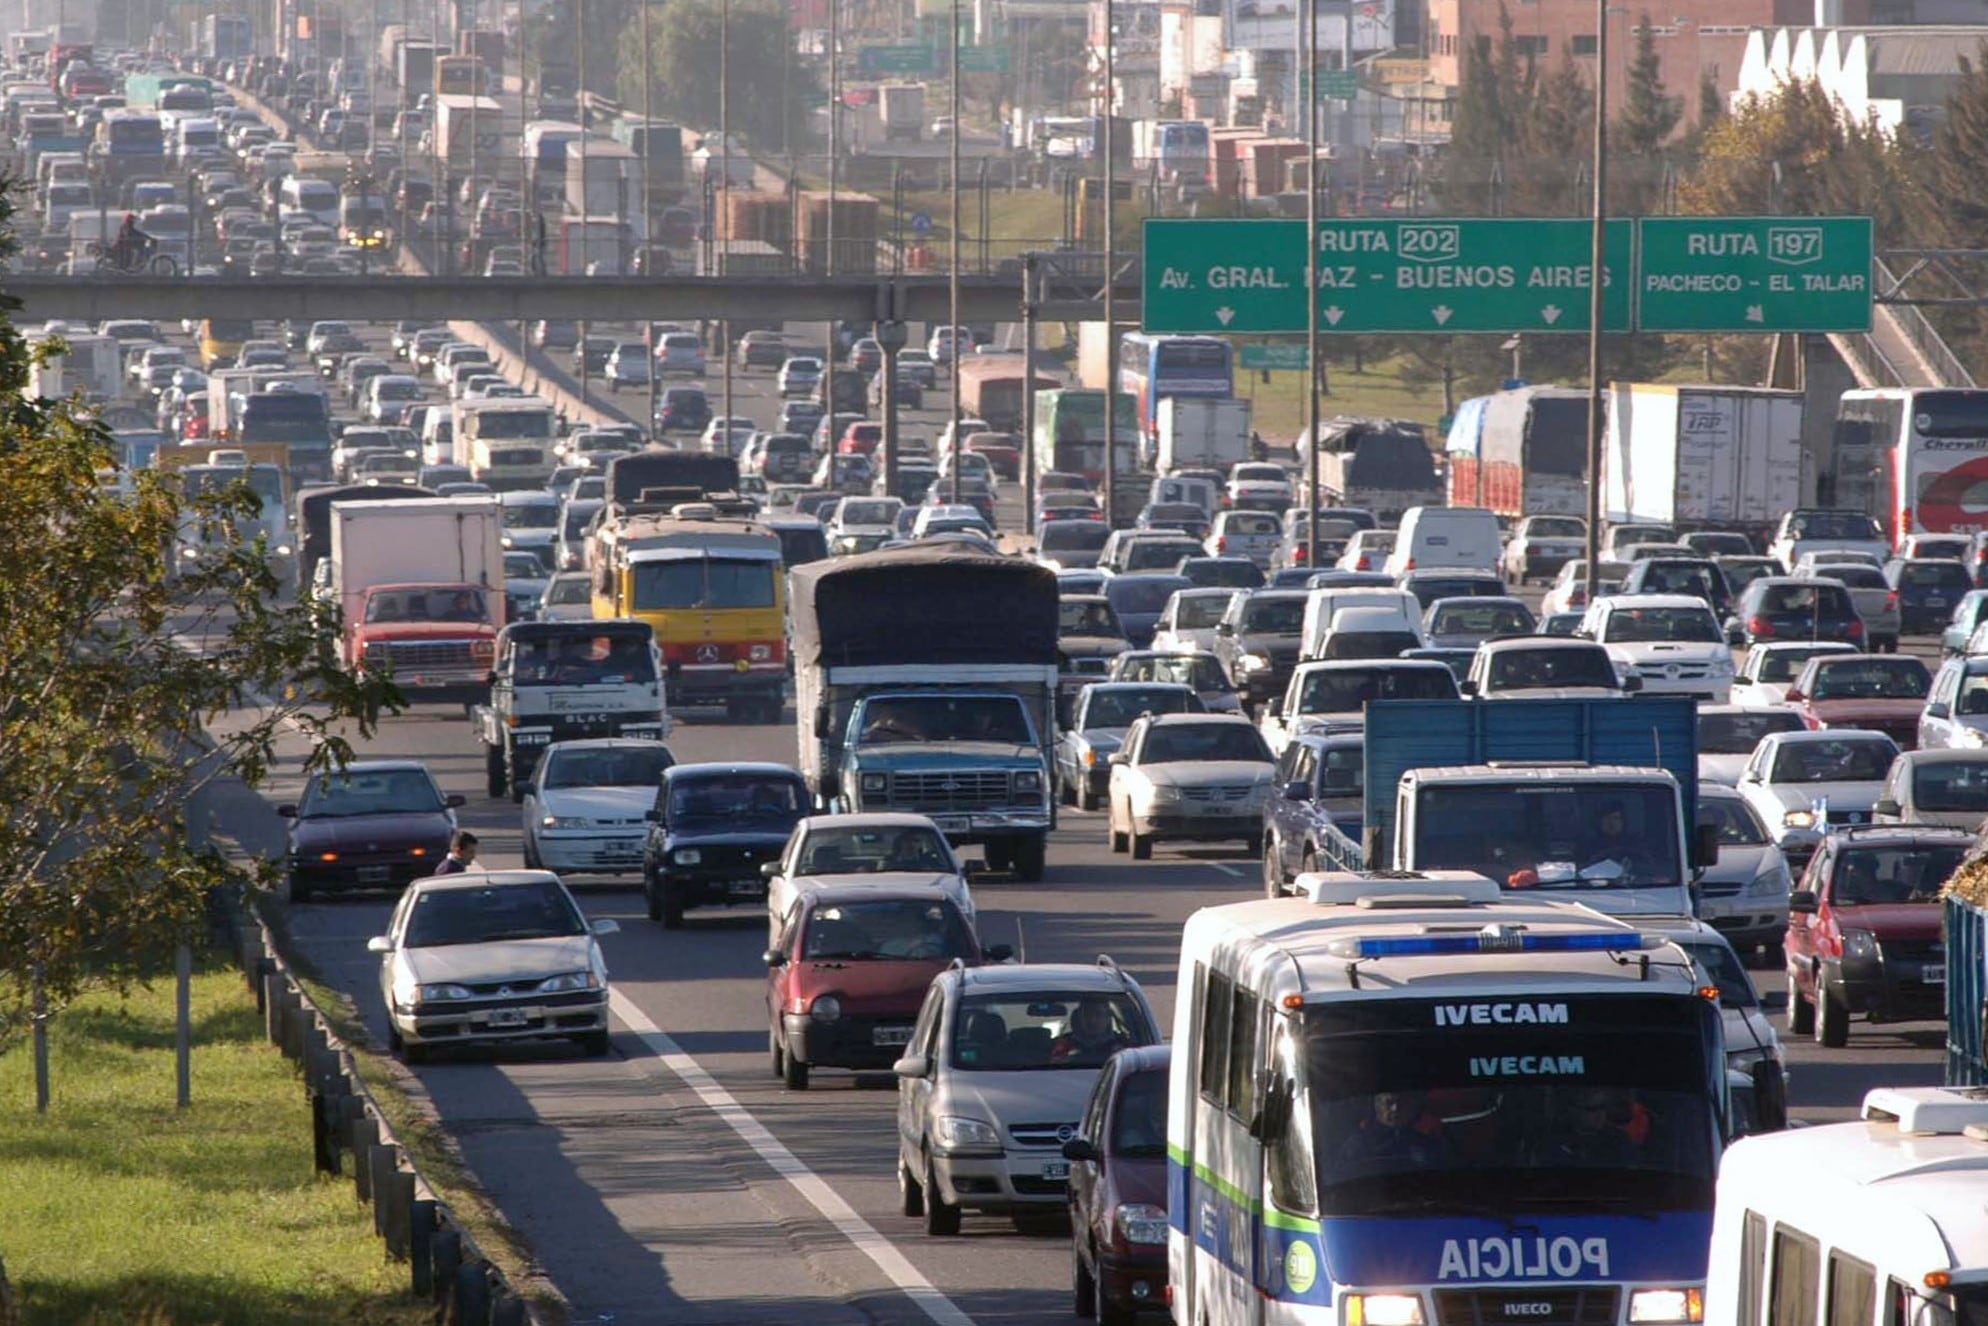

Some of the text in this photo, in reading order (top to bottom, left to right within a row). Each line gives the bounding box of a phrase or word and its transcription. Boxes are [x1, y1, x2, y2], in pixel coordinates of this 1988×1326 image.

[1319, 229, 1455, 252] RUTA 202
[1687, 233, 1820, 256] RUTA 197
[1159, 266, 1196, 289] Av.
[1206, 265, 1290, 289] GRAL.
[1396, 265, 1516, 289] BUENOS
[1646, 274, 1743, 292] PACHECO
[1768, 273, 1795, 292] EL
[1801, 273, 1866, 292] TALAR
[1434, 1002, 1570, 1026] IVECAM
[1470, 1055, 1586, 1077] IVECAM
[1504, 1302, 1553, 1316] IVECO
